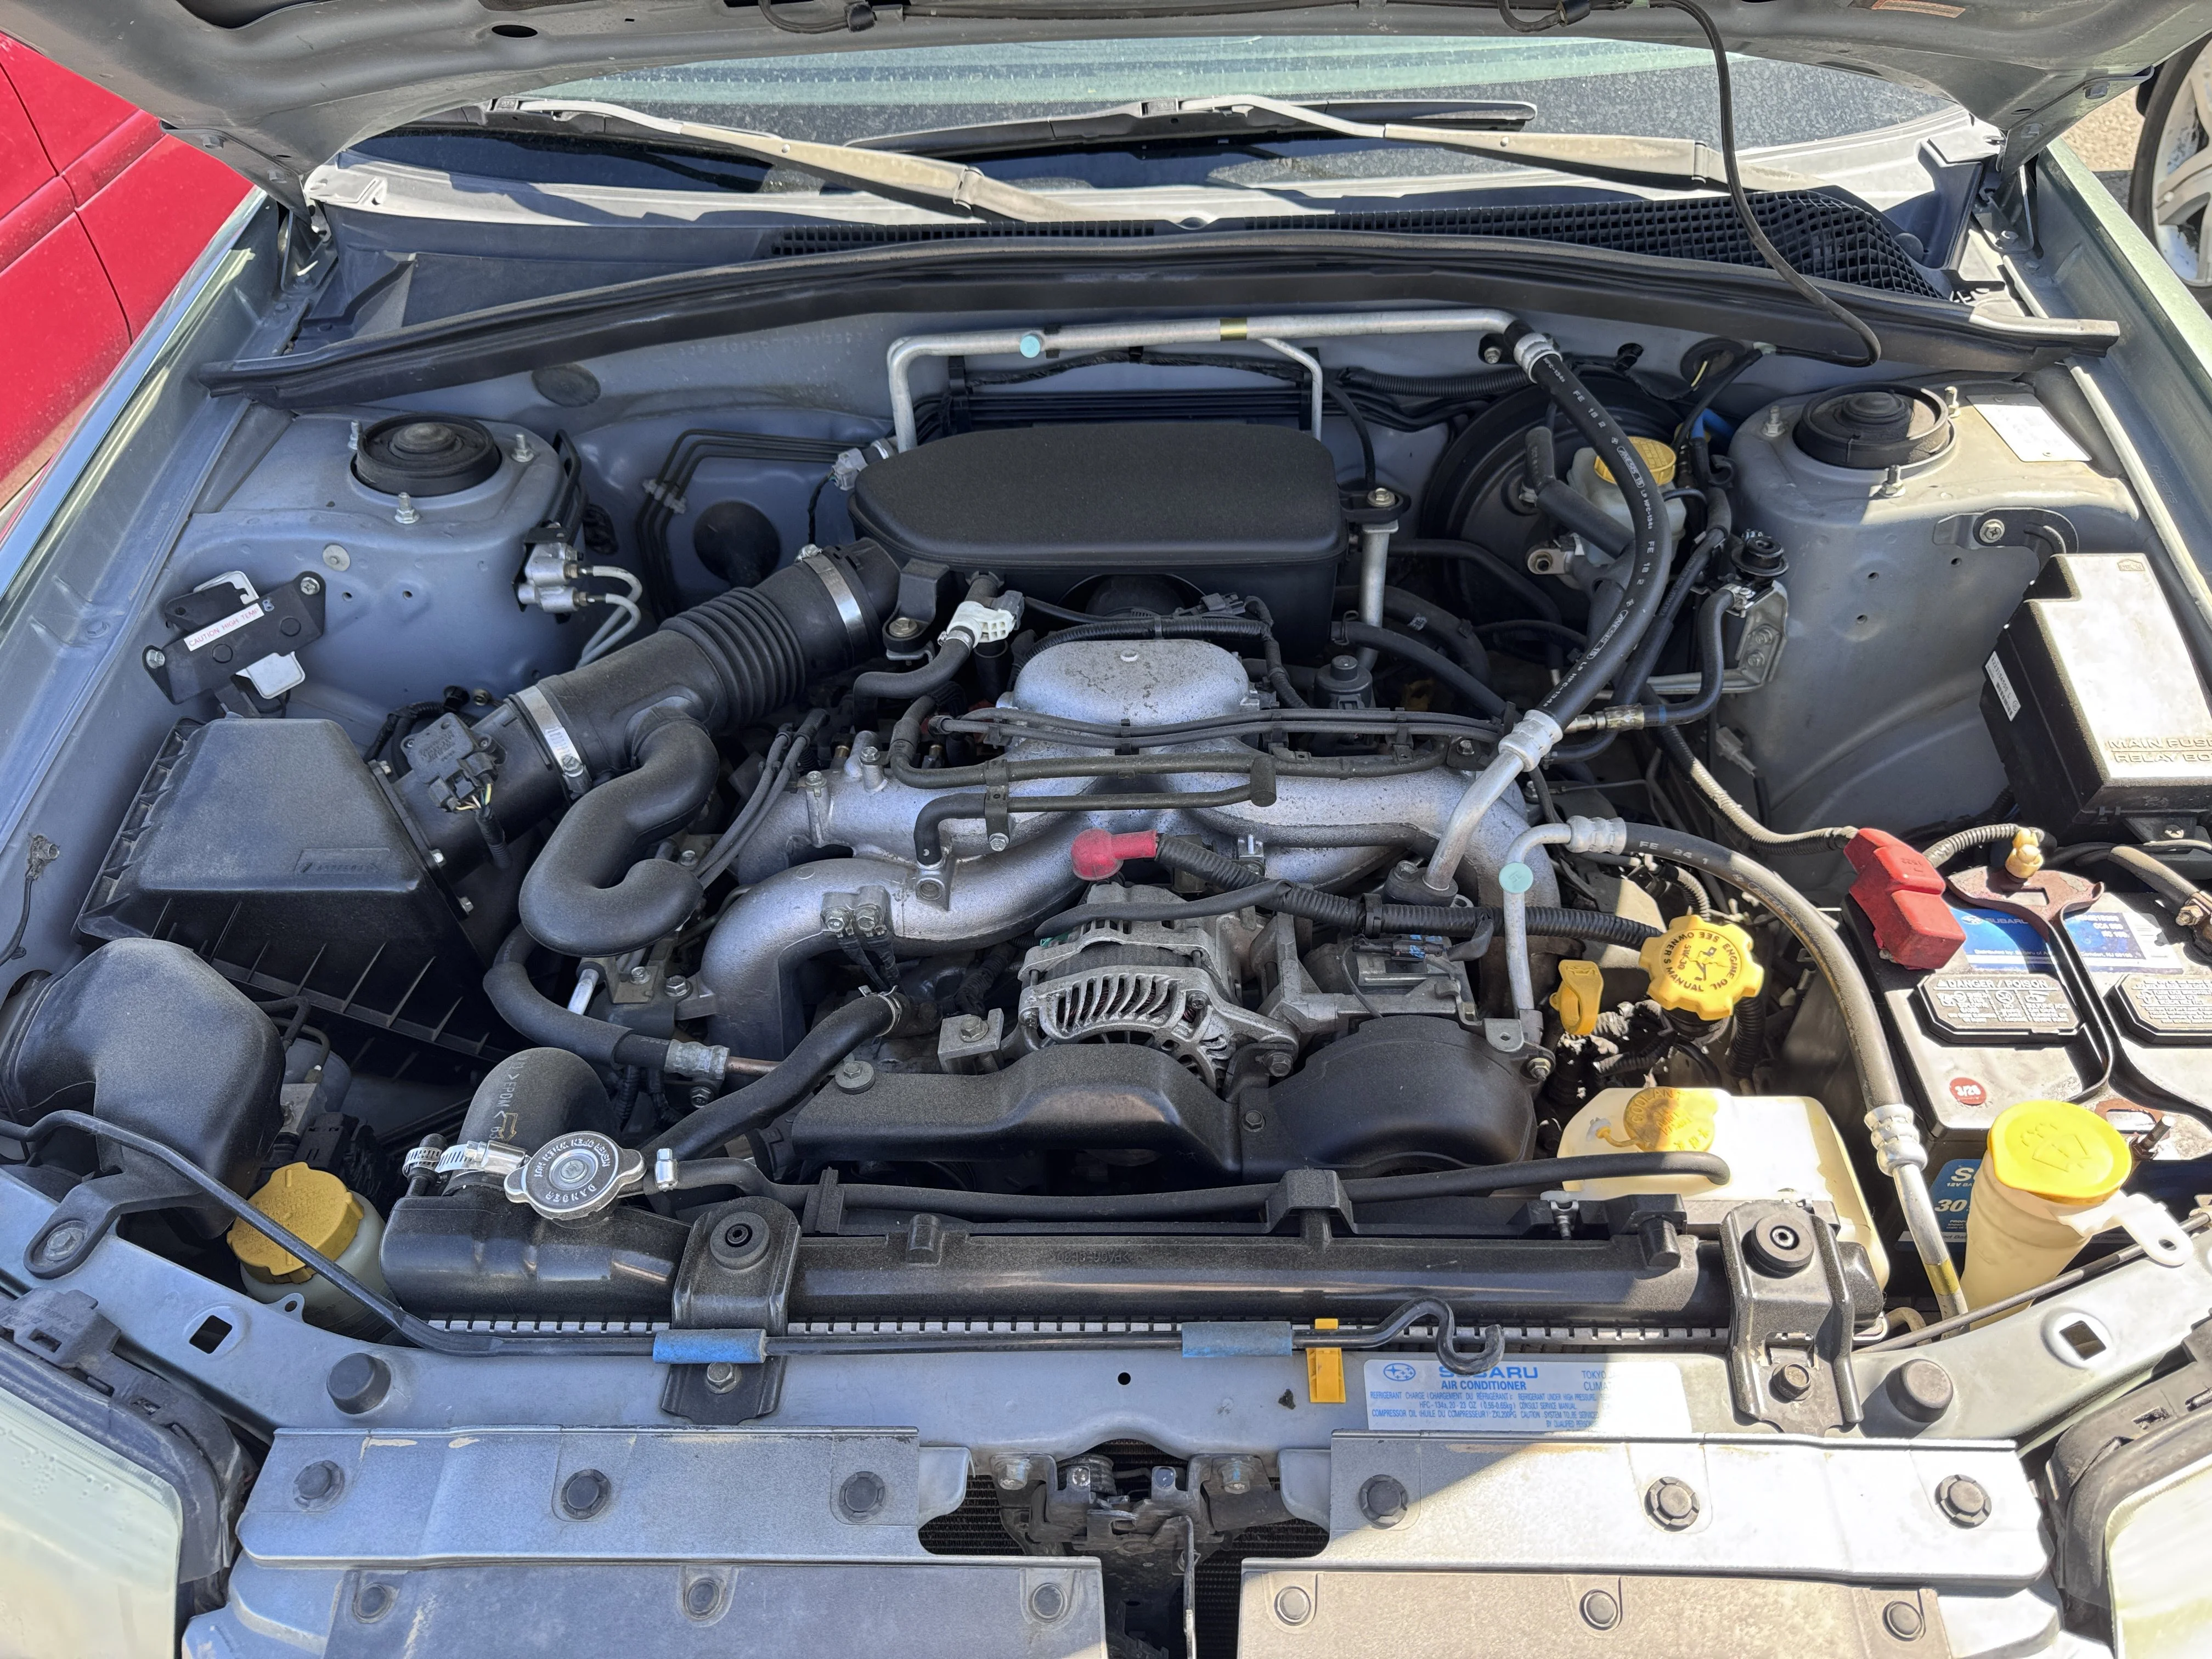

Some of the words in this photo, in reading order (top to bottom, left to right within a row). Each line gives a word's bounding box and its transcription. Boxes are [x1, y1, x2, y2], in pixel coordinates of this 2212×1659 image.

[1572, 390, 1585, 403] FE
[1647, 541, 1655, 554] FE
[189, 628, 220, 646] CAUTION
[221, 618, 239, 630] HIGH
[240, 607, 259, 620] TEMP
[1543, 673, 1577, 707] HFC-134a
[2108, 738, 2163, 749] MAIN
[2114, 753, 2176, 763] RELAY
[2182, 753, 2212, 762] BO
[1639, 840, 1659, 850] FE
[1672, 849, 1692, 859] 24
[1699, 932, 1720, 943] SEE
[1722, 943, 1737, 979] ENGINE
[1666, 966, 1704, 992] MANUAL
[1709, 978, 1728, 990] OIL
[1947, 979, 1995, 988] DANGER
[2004, 980, 2048, 988] POISON
[571, 1138, 595, 1148] OPEN
[543, 1141, 569, 1161] WHEN
[533, 1161, 547, 1178] HOT
[545, 1183, 597, 1203] DANGER
[1438, 1366, 1538, 1379] SARU
[1581, 1370, 1606, 1379] TOKYO
[1441, 1380, 1458, 1390] AIR
[1460, 1380, 1527, 1390] CONDITIONER
[1583, 1381, 1611, 1391] CLIMAT
[1370, 1391, 1402, 1400] REFRIGERANT
[1406, 1391, 1425, 1400] CHARGE
[1372, 1409, 1407, 1418] COMPRESSOR
